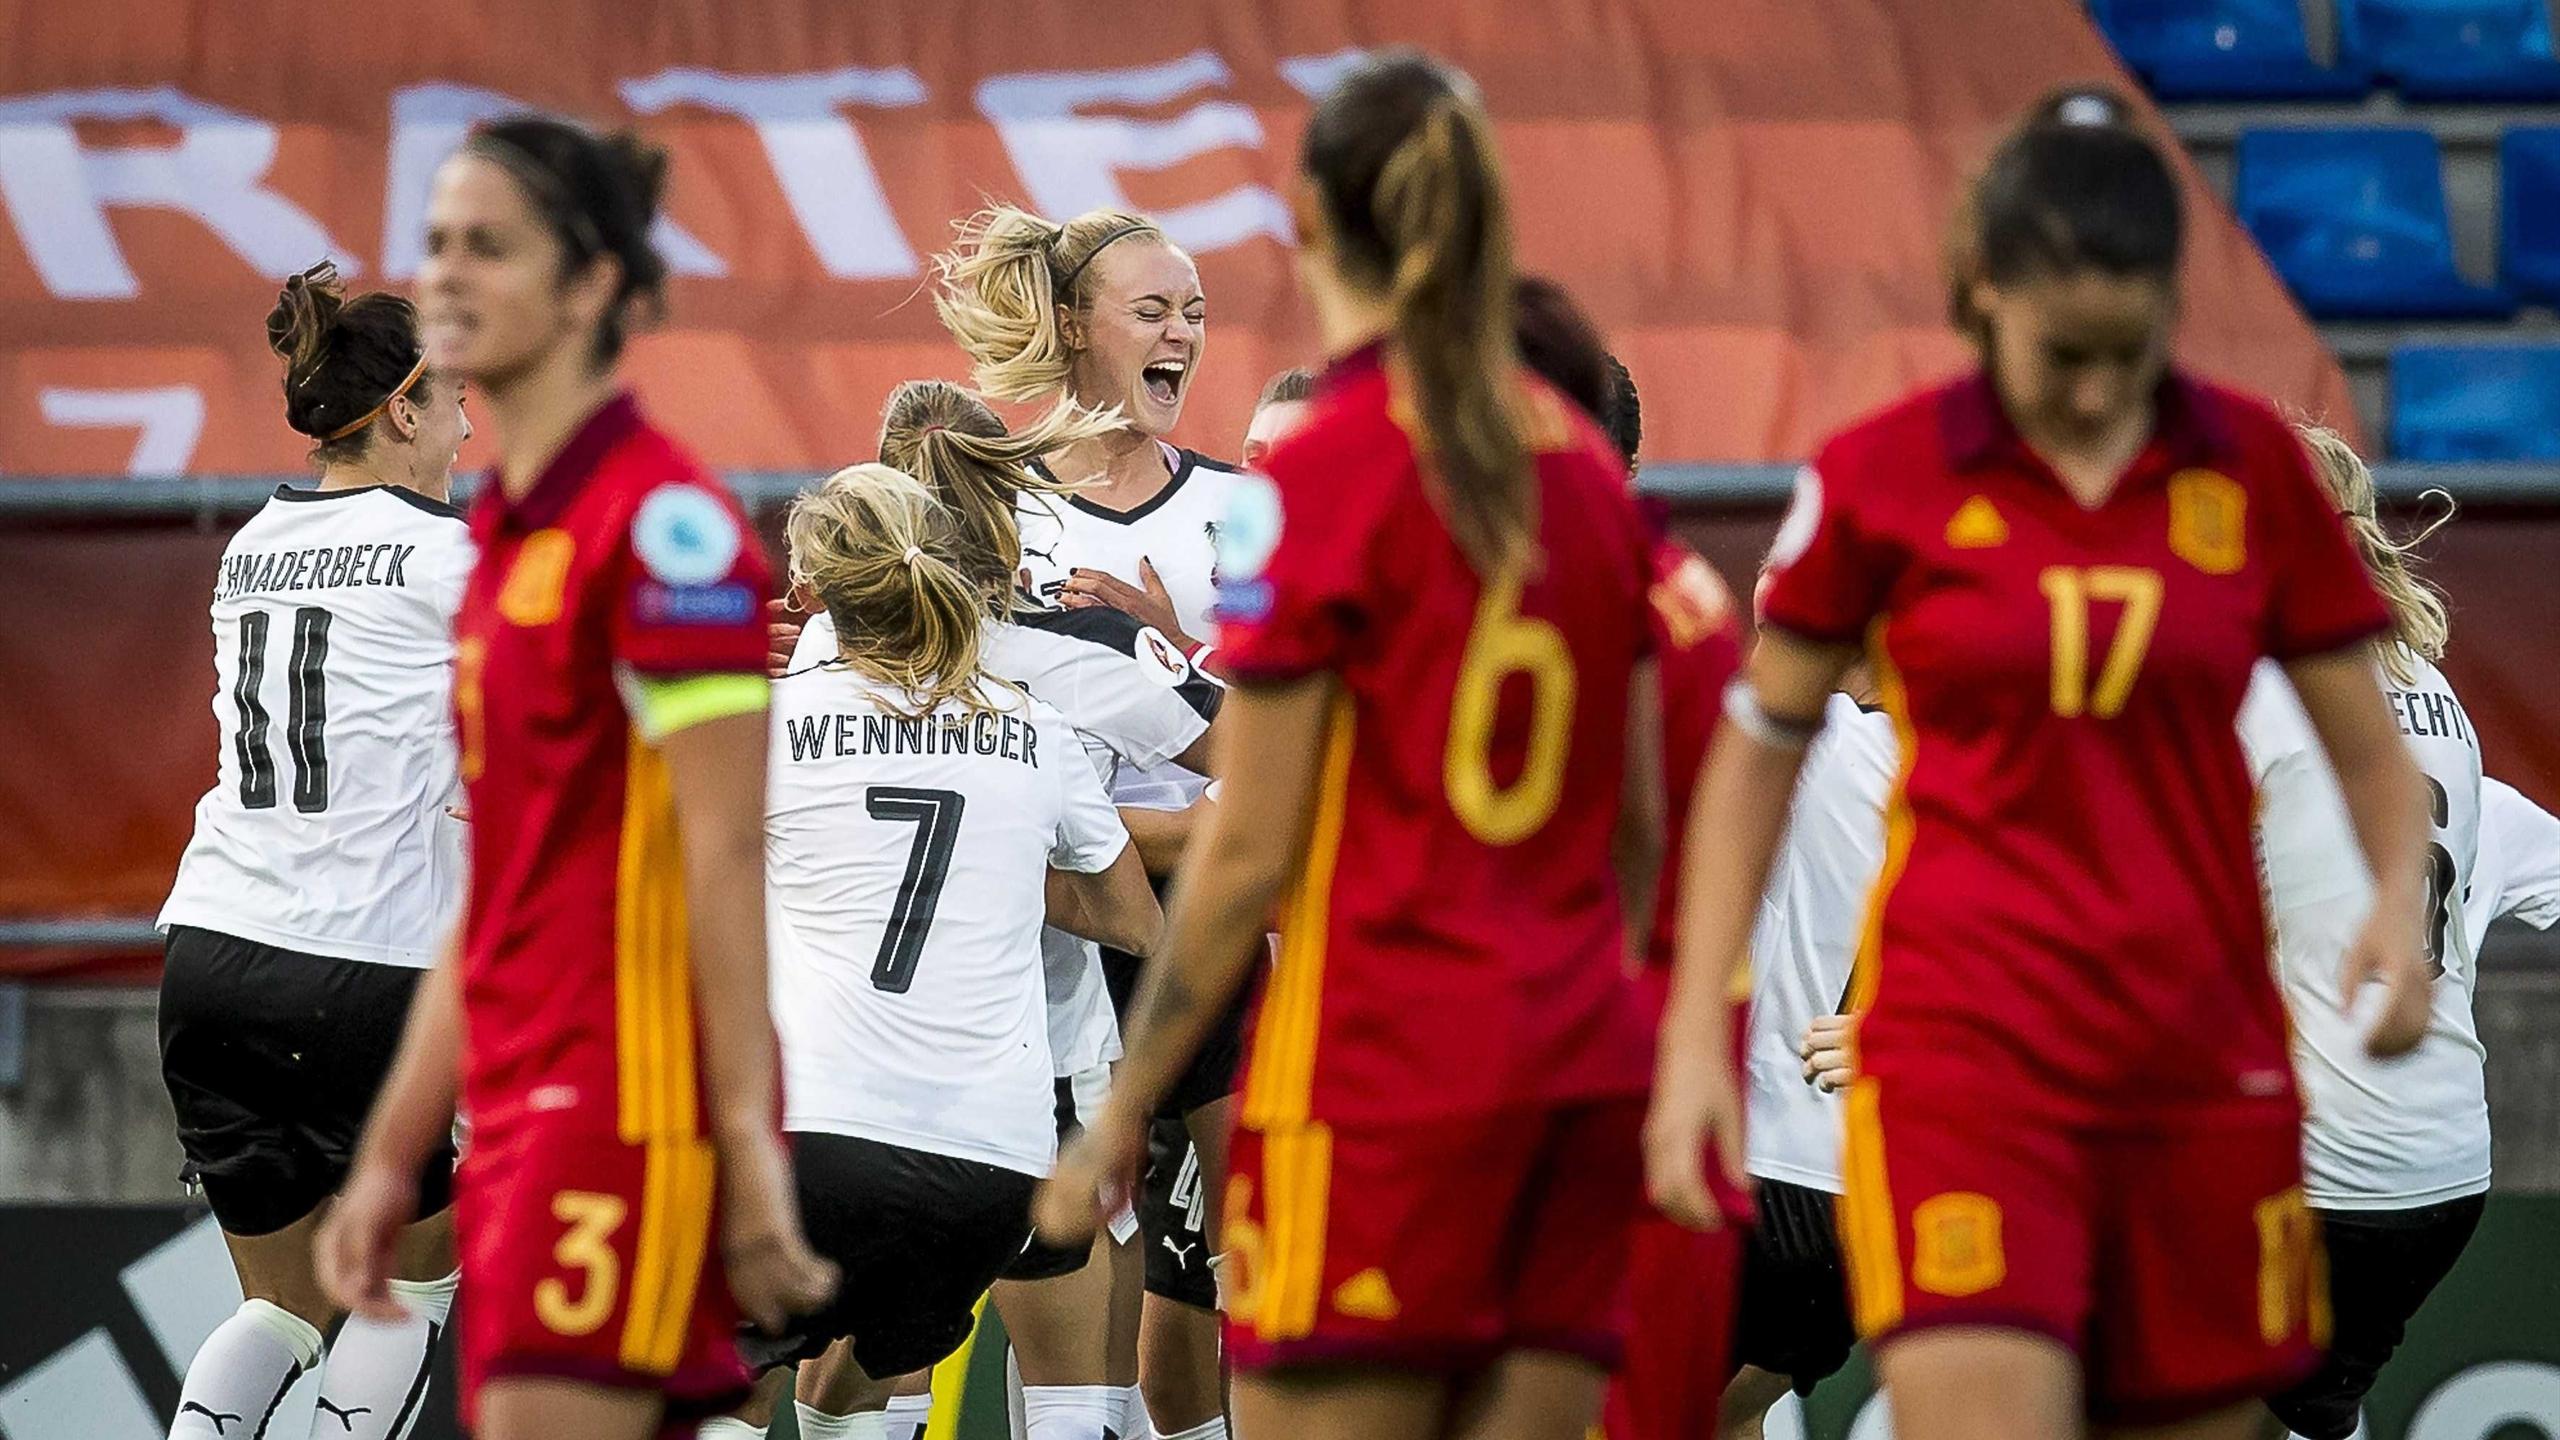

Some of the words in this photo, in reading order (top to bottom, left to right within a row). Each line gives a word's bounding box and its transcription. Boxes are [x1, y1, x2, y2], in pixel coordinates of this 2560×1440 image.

[216, 544, 415, 601] HNADERBECK
[2038, 564, 2166, 719] 17
[234, 607, 332, 813] 11
[786, 712, 1039, 769] WENNINGER
[1443, 560, 1577, 846] 6
[866, 786, 965, 993] 7
[534, 1190, 627, 1336] 3
